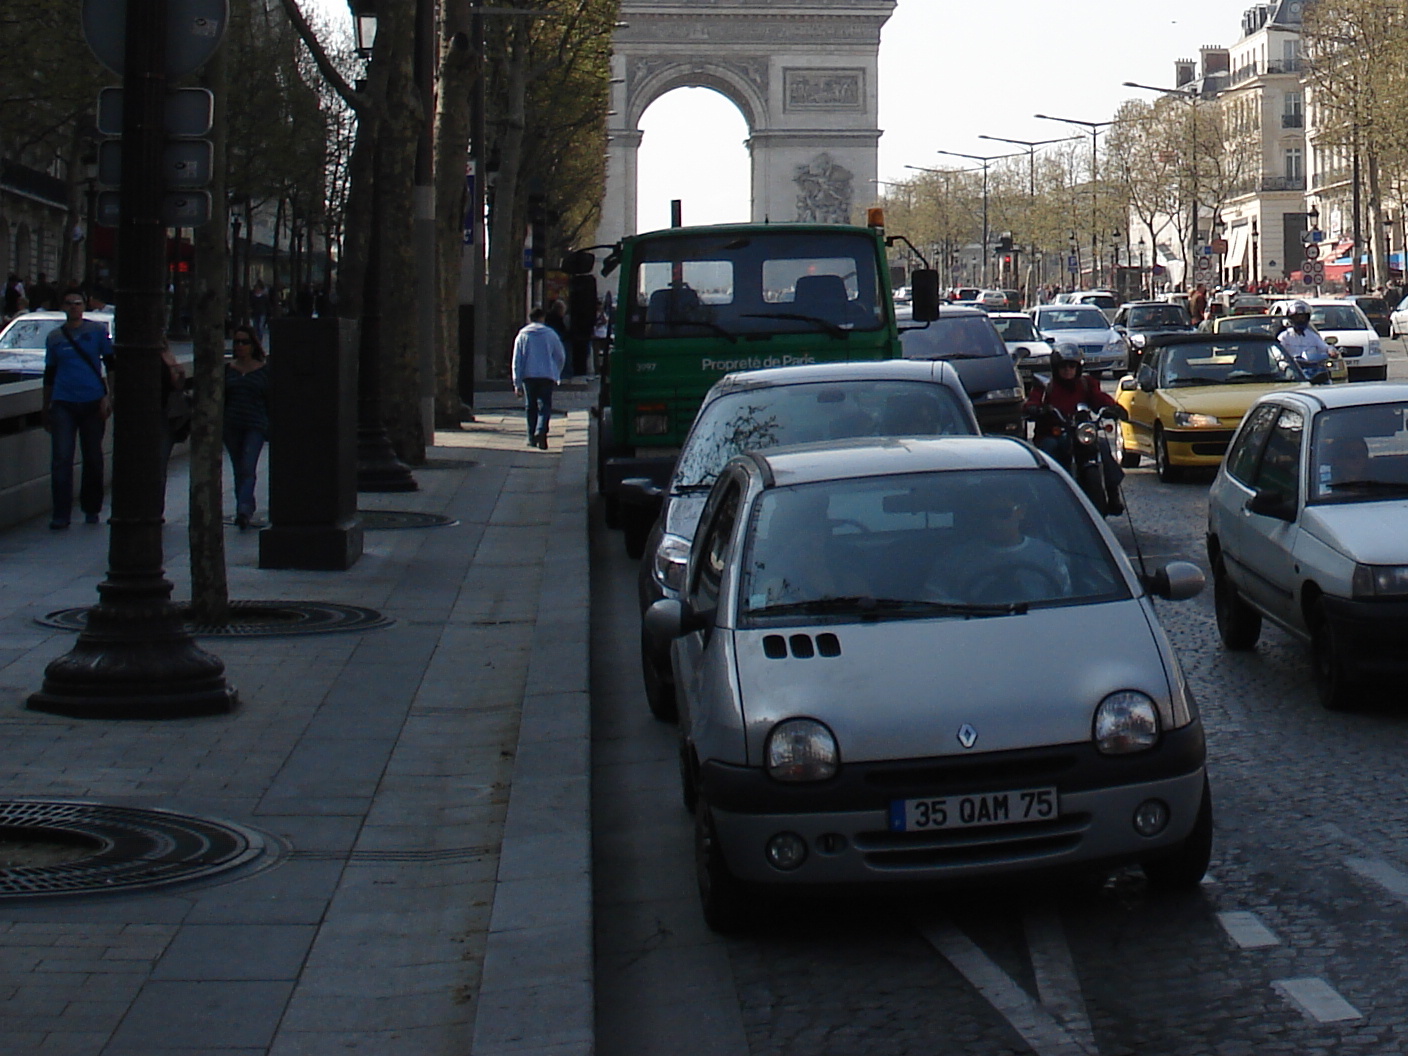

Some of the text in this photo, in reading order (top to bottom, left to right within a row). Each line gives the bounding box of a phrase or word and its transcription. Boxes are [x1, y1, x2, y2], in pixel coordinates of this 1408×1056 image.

[701, 353, 816, 372] Propreté de Paris
[914, 790, 1053, 827] 35 QAM 75
